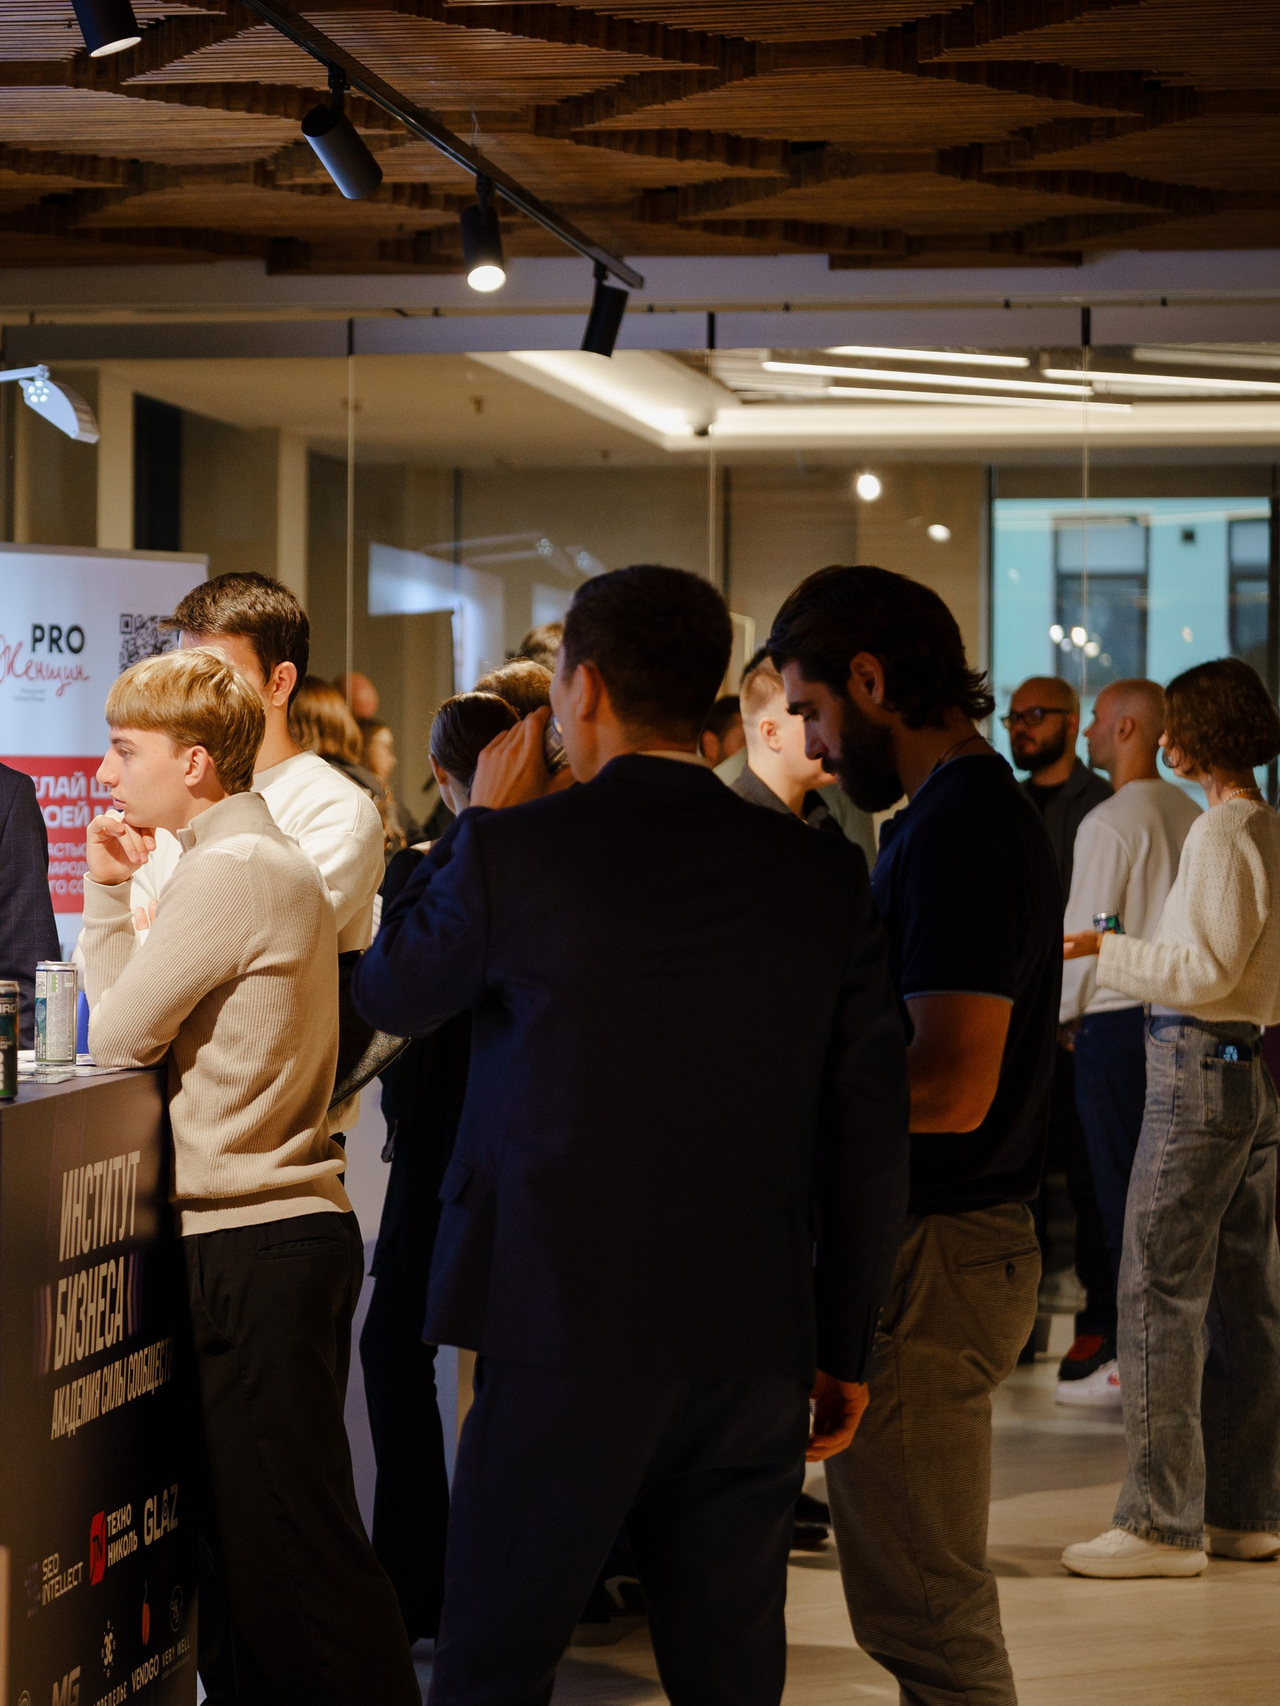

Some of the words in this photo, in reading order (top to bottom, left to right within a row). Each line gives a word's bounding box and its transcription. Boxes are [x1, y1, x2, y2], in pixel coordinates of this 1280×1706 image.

[32, 623, 85, 654] PRO
[59, 1150, 140, 1262] ИНСТИТУТ
[54, 1256, 125, 1371] БИЗНЕСА
[51, 1369, 101, 1440] АКАДЕМИЯ
[101, 1357, 127, 1416] СИЛЫ
[127, 1338, 173, 1401] СООБЩЕСТ
[107, 1503, 132, 1537] ТЕХНО
[144, 1482, 179, 1546] GLAZ
[42, 1553, 60, 1581] SEO
[108, 1529, 138, 1567] НИКОЛЬ
[41, 1562, 83, 1606] INTELLECT
[131, 1654, 160, 1692] VENDGO
